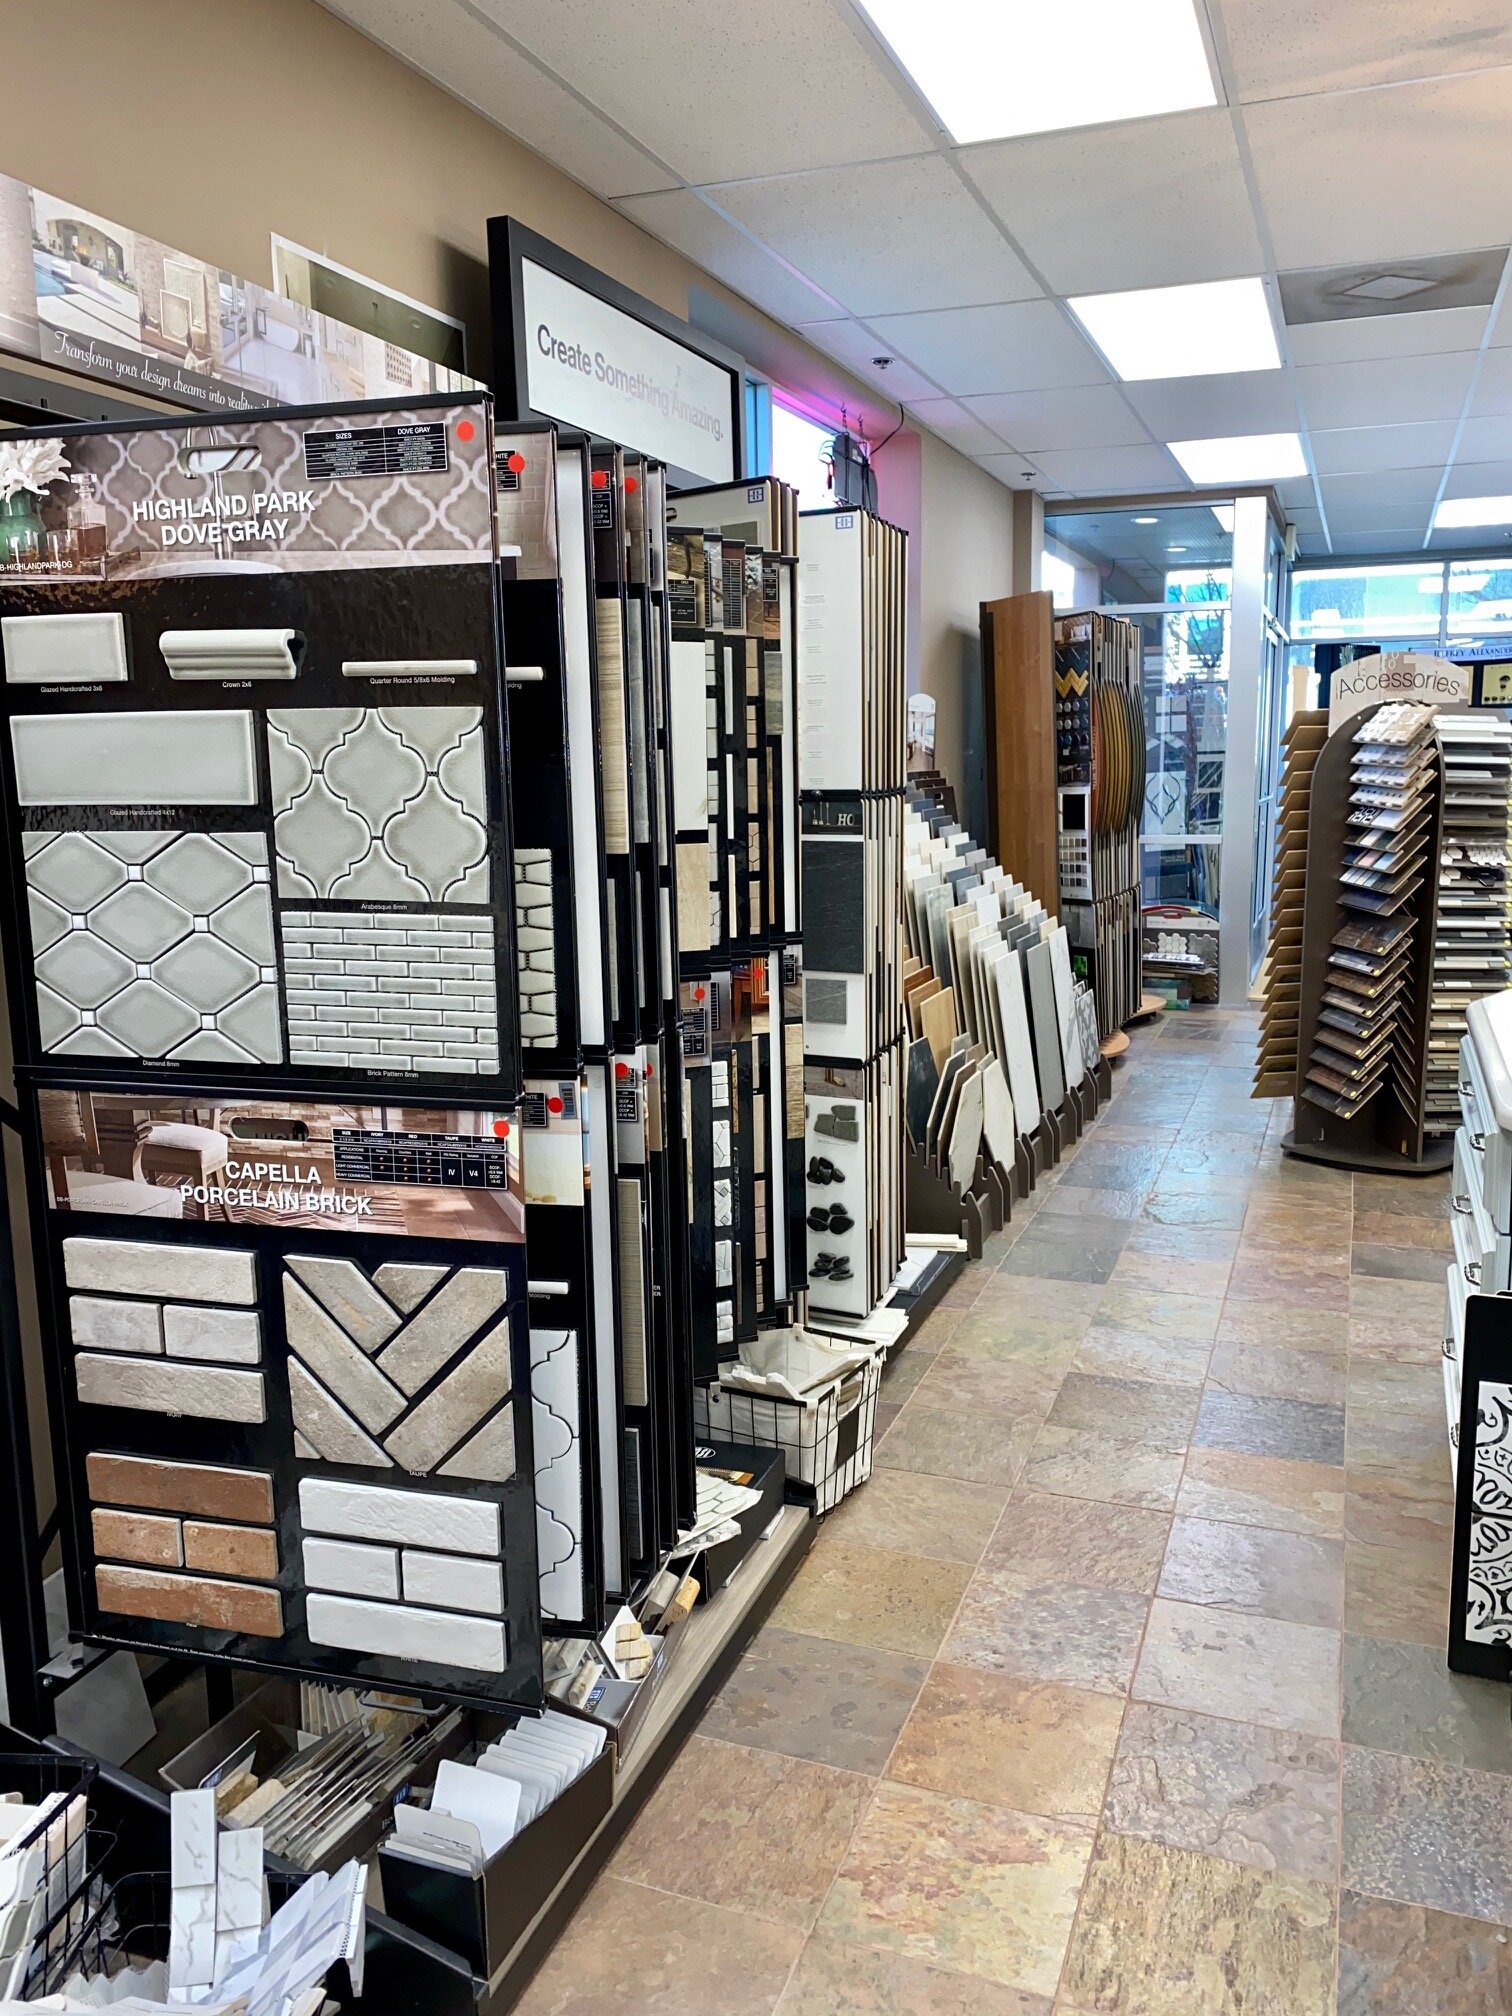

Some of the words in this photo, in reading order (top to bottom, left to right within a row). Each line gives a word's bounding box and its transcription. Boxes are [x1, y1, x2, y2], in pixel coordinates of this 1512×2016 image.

[54, 331, 112, 370] Transform
[116, 361, 138, 378] your
[141, 359, 171, 391] design
[173, 371, 206, 399] dreams
[209, 386, 225, 404] into
[537, 324, 592, 376] Create
[595, 352, 669, 417] Something
[672, 388, 724, 441] Amazing.
[335, 432, 352, 440] SIZES
[397, 427, 414, 436] DOVE
[414, 426, 431, 435] GRAY
[132, 494, 248, 521] HIGHLAND
[254, 490, 316, 514] PARK
[161, 522, 222, 546] DOVE
[227, 518, 289, 543] GRAY
[370, 677, 392, 685] Quarter
[431, 676, 455, 684] Molding
[1337, 669, 1460, 700] Accessories
[361, 903, 391, 911] Arabesque
[142, 1059, 165, 1067] Diamond
[225, 1161, 322, 1185] CAPELLA
[448, 1168, 456, 1176] IV
[180, 1185, 299, 1211] PORCELAIN
[305, 1193, 373, 1216] BRICK
